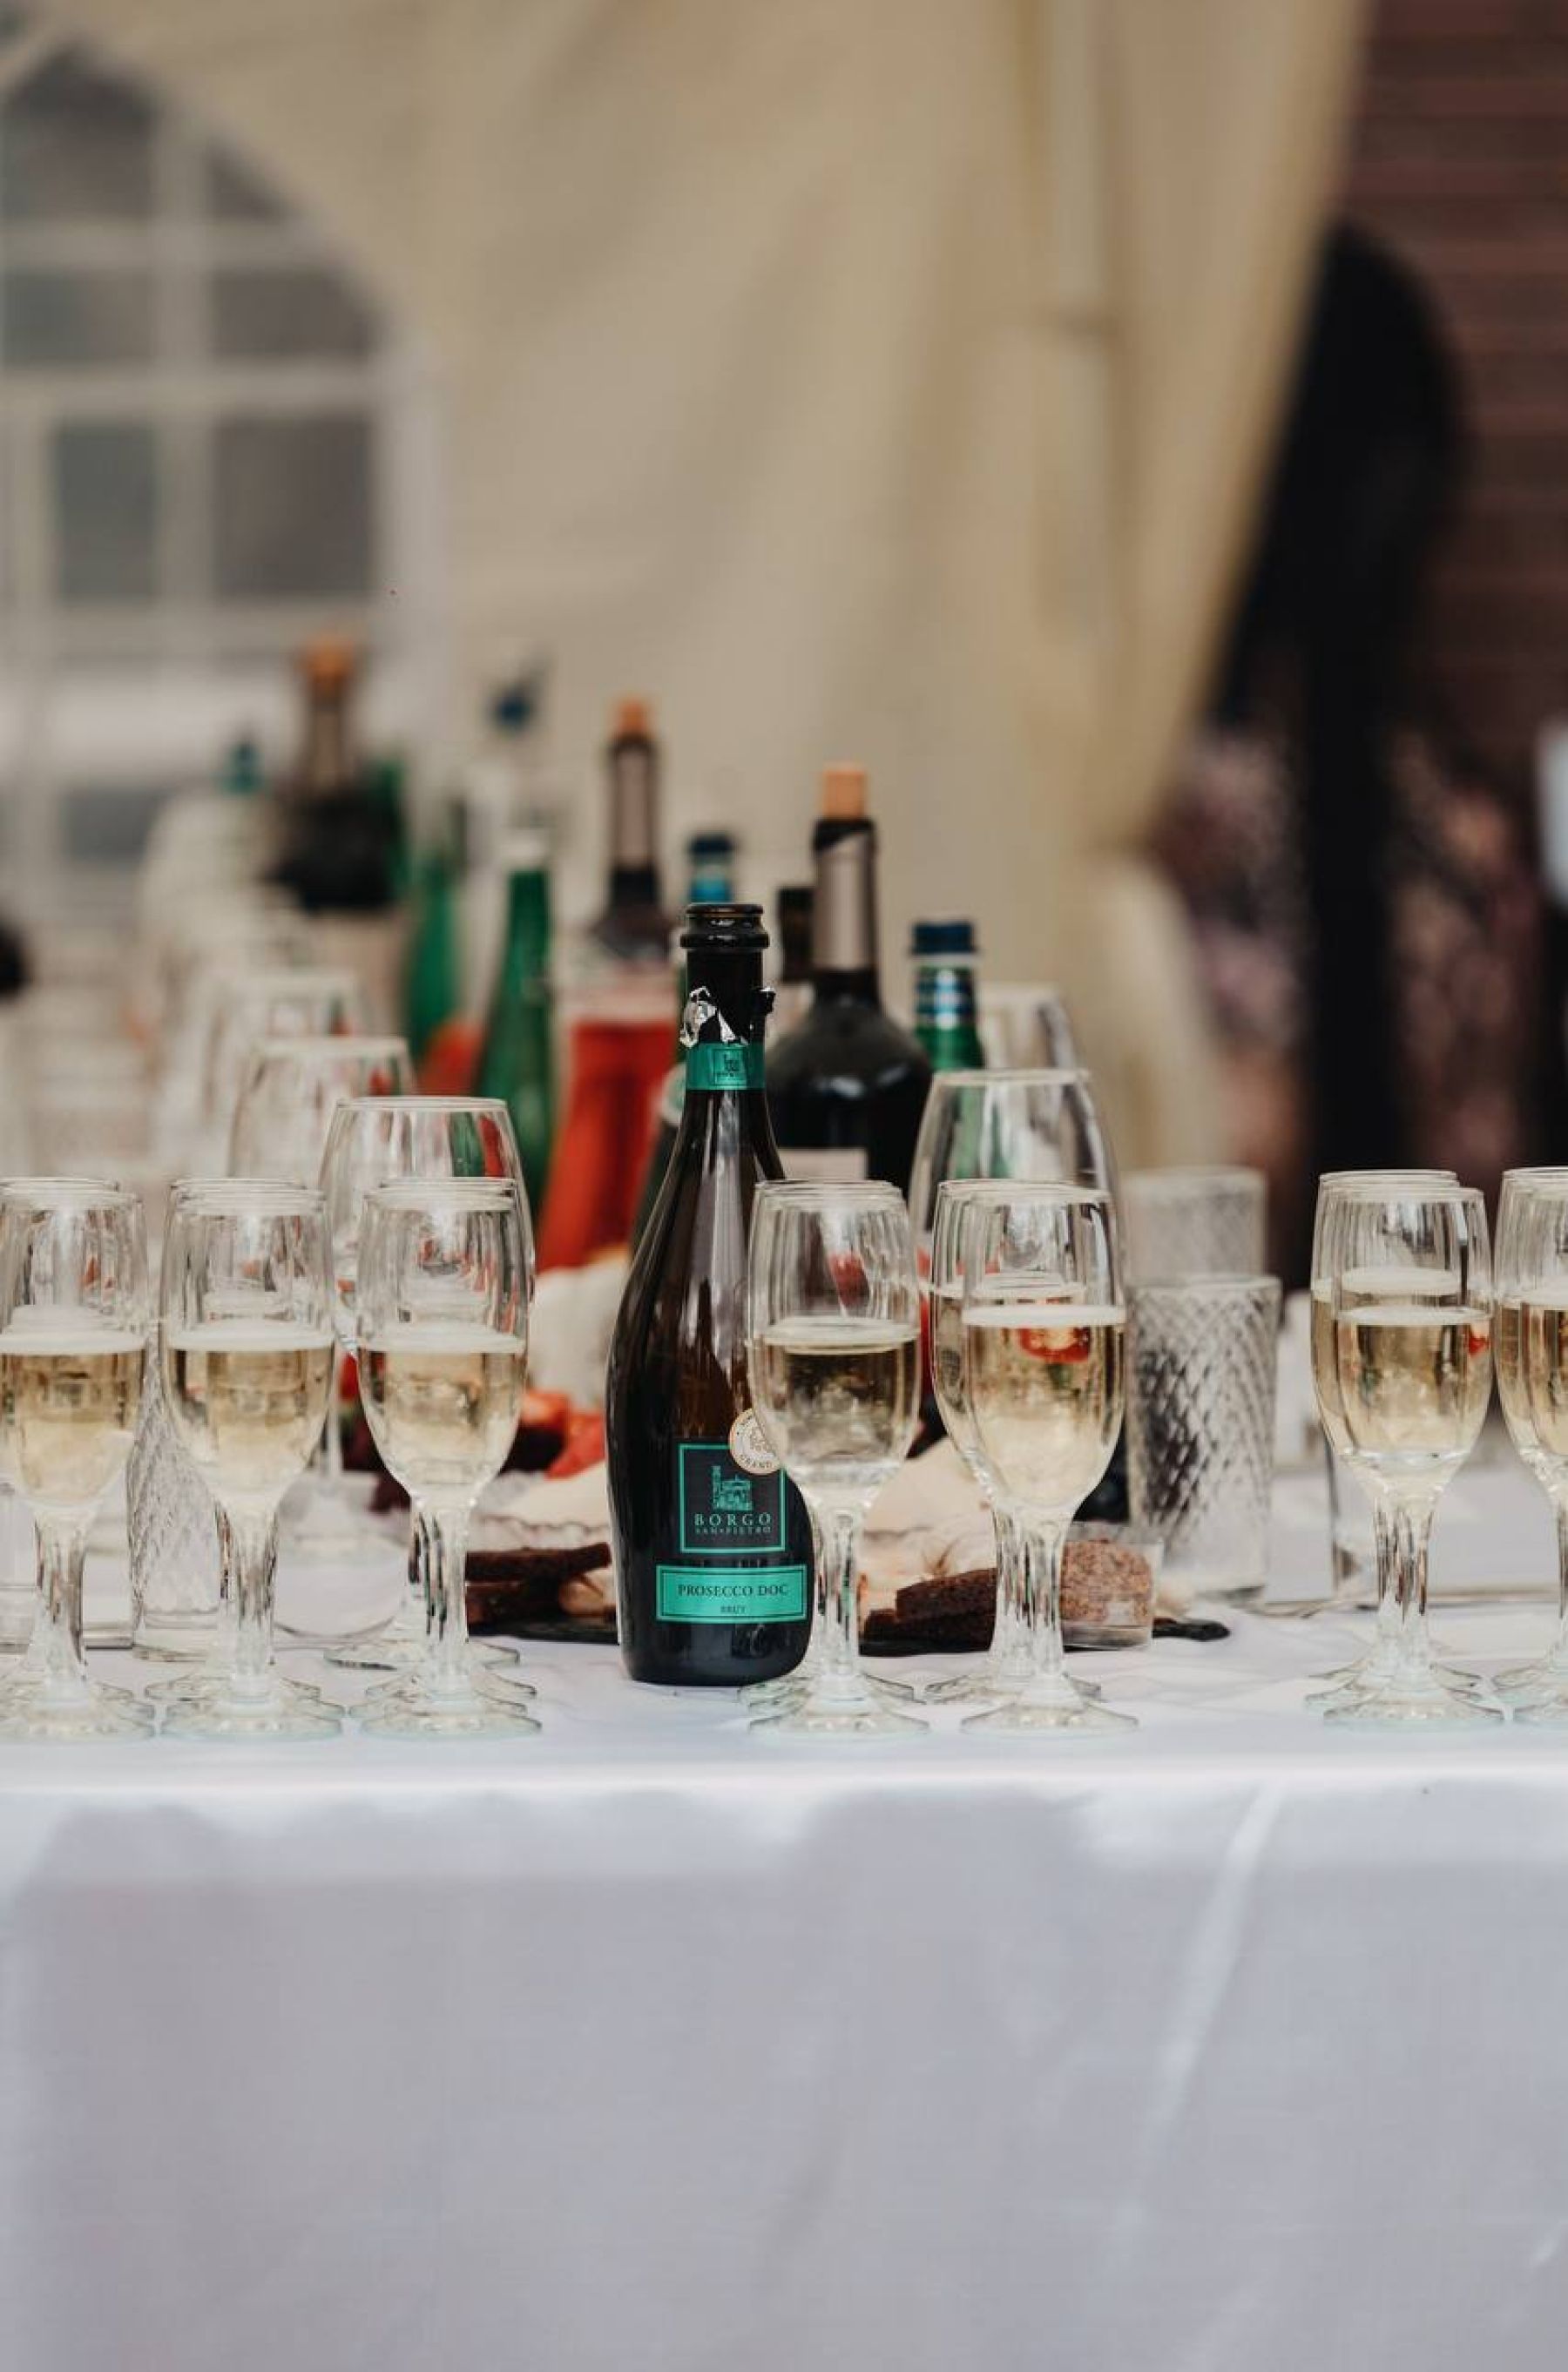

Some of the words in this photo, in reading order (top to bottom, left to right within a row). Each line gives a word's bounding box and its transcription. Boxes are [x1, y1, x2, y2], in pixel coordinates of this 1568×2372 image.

[694, 1512, 772, 1526] BORGO
[679, 1584, 753, 1597] PROSECCO
[758, 1584, 789, 1596] DOC
